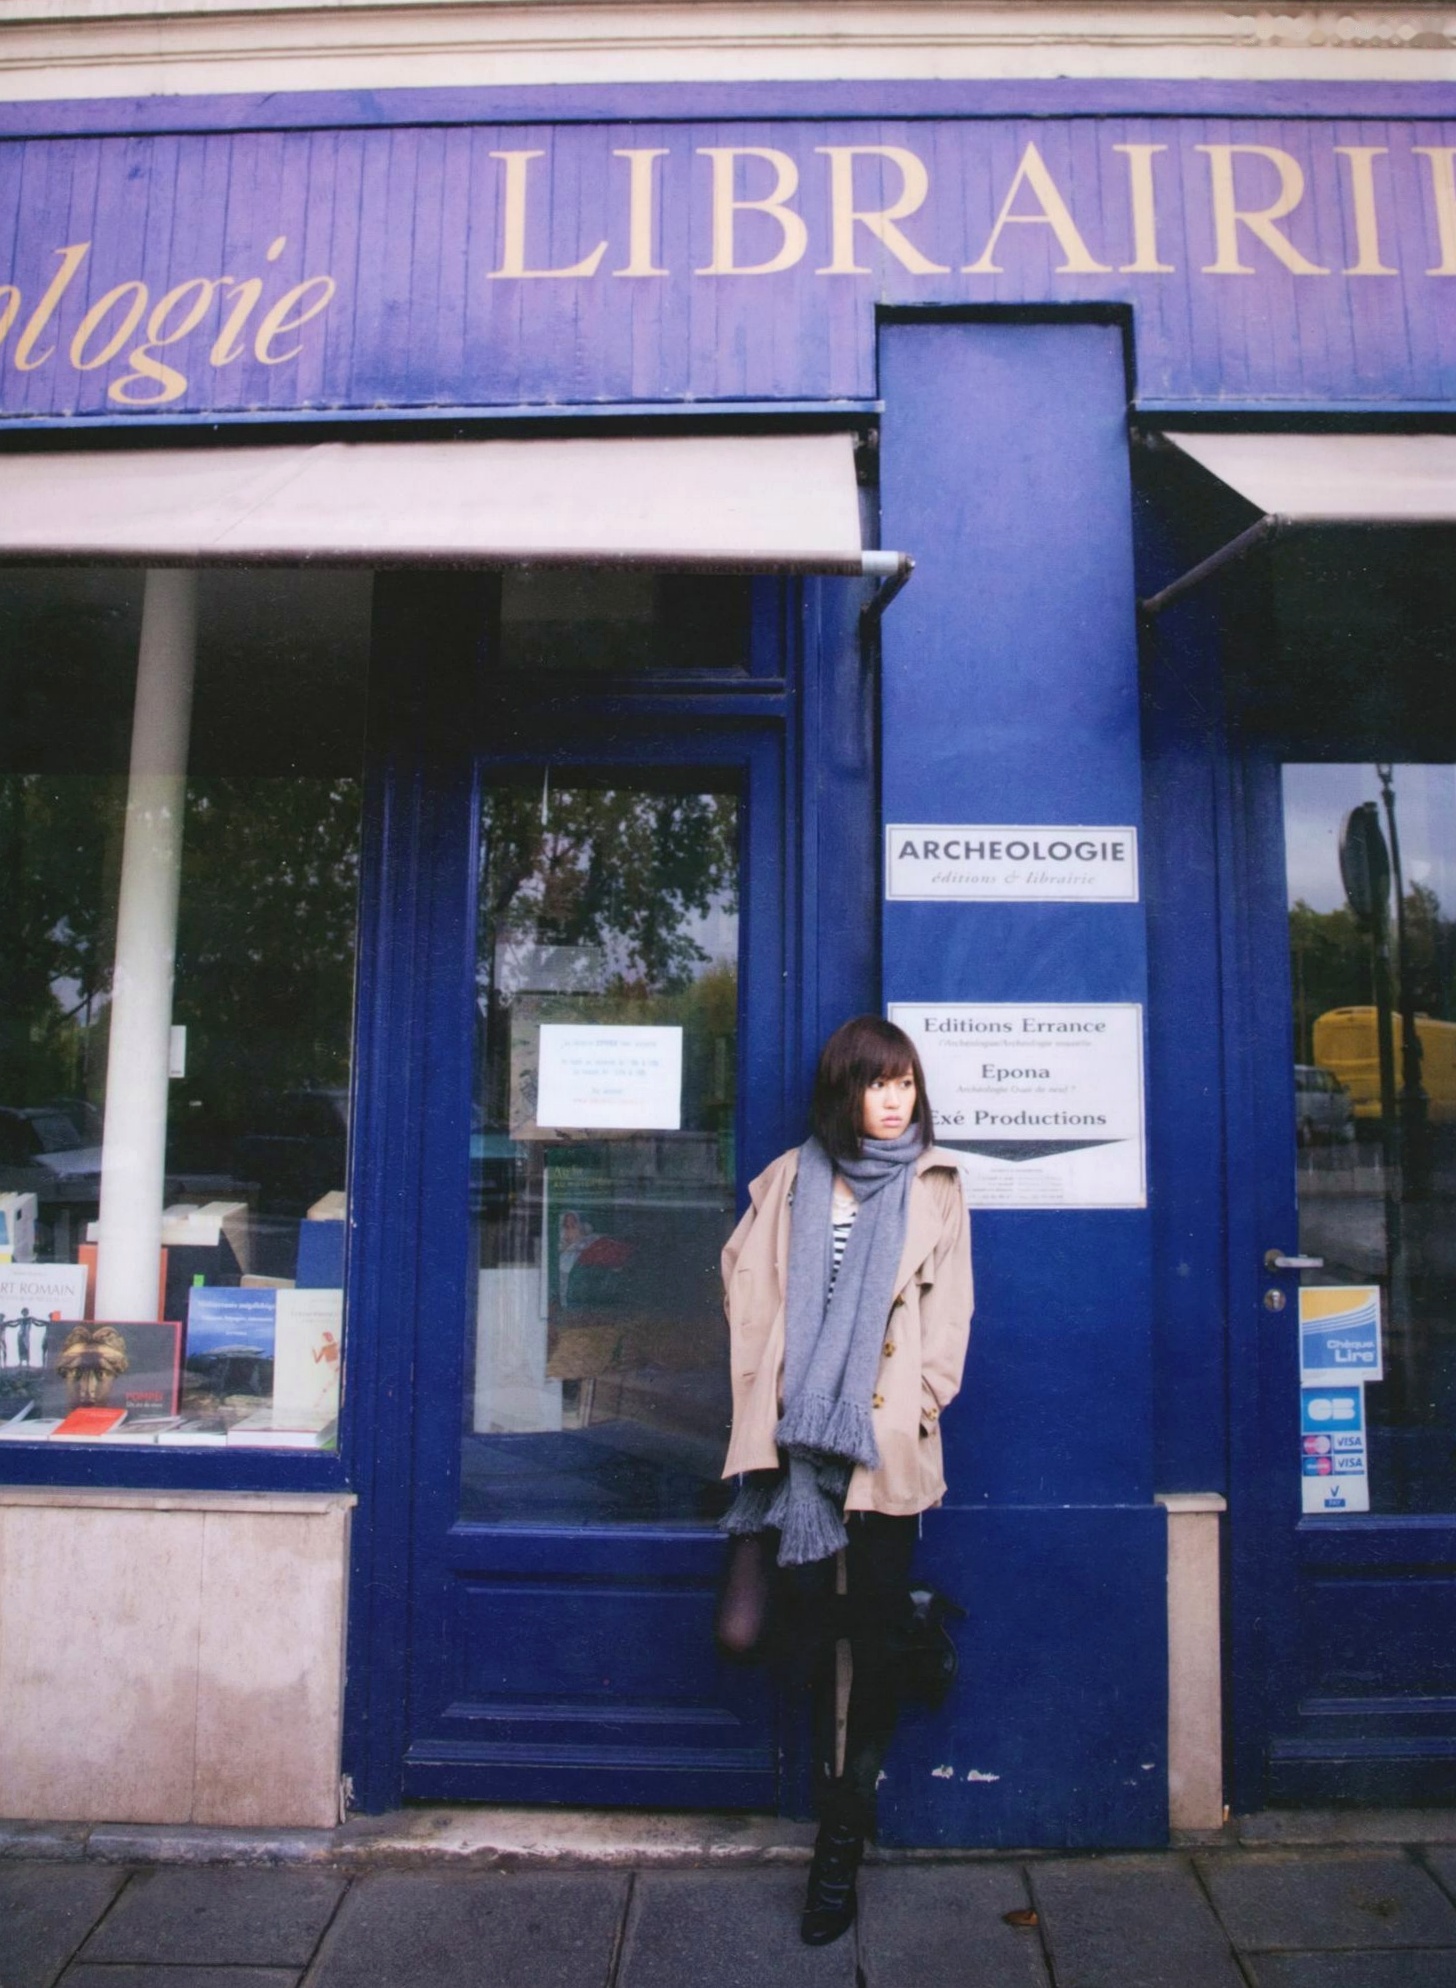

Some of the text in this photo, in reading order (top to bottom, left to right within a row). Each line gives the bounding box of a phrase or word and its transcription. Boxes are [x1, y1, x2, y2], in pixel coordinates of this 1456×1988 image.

[0, 236, 336, 405] logie
[898, 840, 1126, 862] ARCHEOLOGIE
[931, 870, 1096, 885] éditions & librairie
[924, 1017, 1107, 1034] Editions Errance
[981, 1064, 1051, 1082] Epona
[974, 1109, 1108, 1126] Productions
[20, 1282, 76, 1296] ROMAIN
[1335, 1349, 1374, 1362] Lire
[1337, 1436, 1362, 1447] VISA
[1338, 1457, 1363, 1468] VISA
